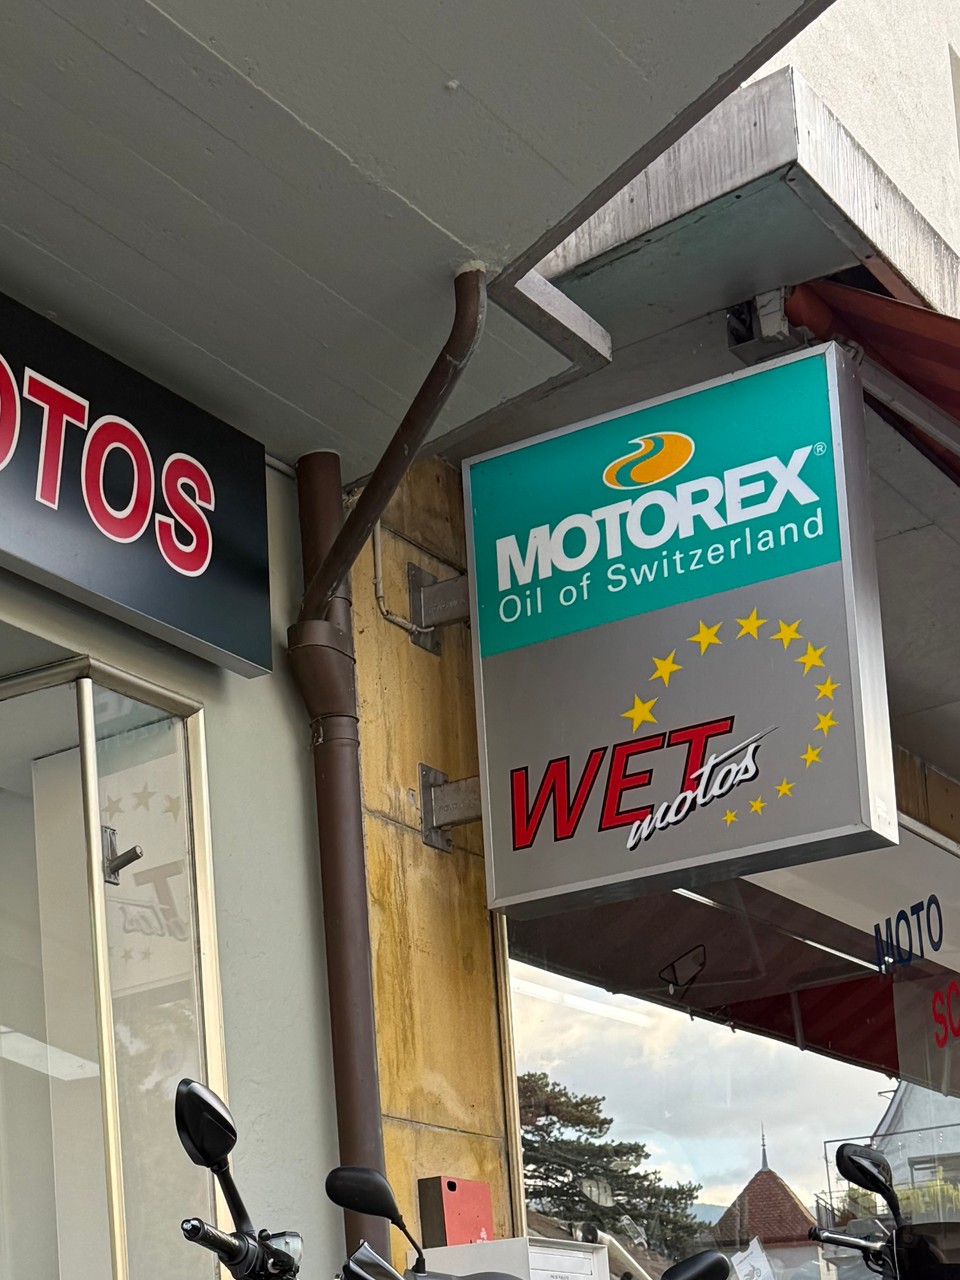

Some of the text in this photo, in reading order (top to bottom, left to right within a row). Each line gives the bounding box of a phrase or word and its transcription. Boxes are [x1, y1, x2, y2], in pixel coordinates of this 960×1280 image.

[499, 508, 824, 623] Oil of Switzerland
[510, 715, 736, 851] WET
[626, 725, 779, 851] motos
